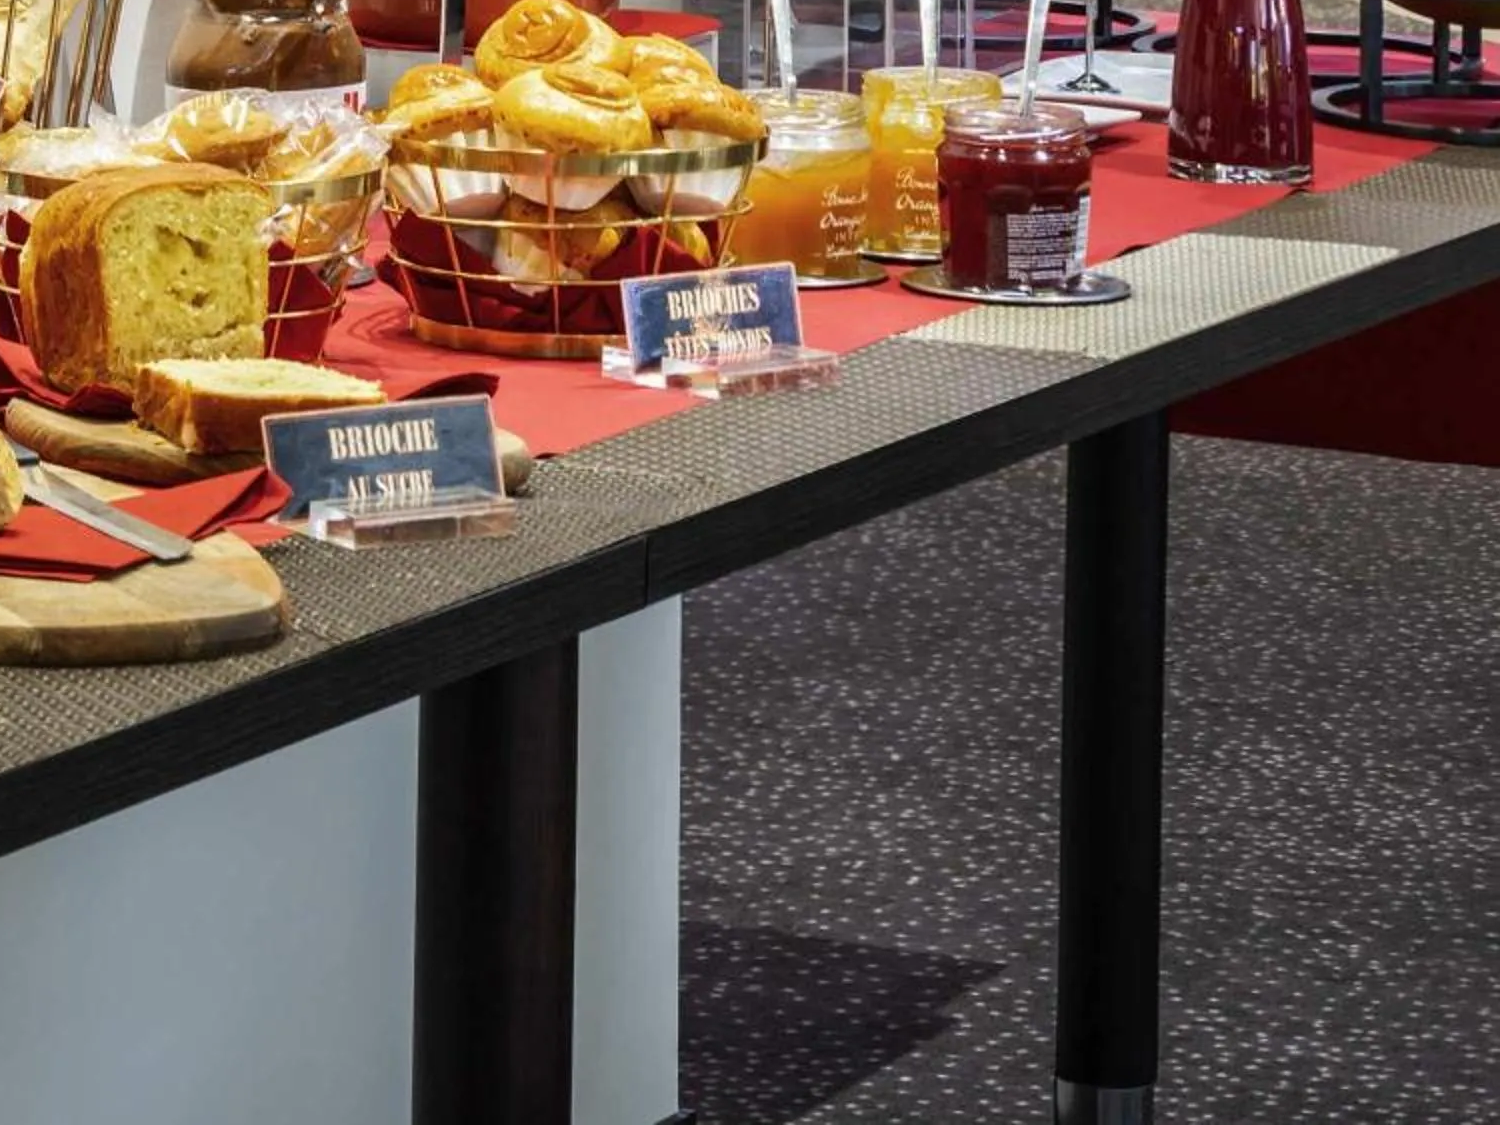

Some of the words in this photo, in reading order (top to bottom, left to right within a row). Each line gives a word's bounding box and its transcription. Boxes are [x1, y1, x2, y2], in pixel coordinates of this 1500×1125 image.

[667, 283, 760, 320] BRIOCHES
[328, 418, 438, 460] BRIOCHE
[348, 475, 371, 500] AU
[374, 469, 434, 500] SUCRE
